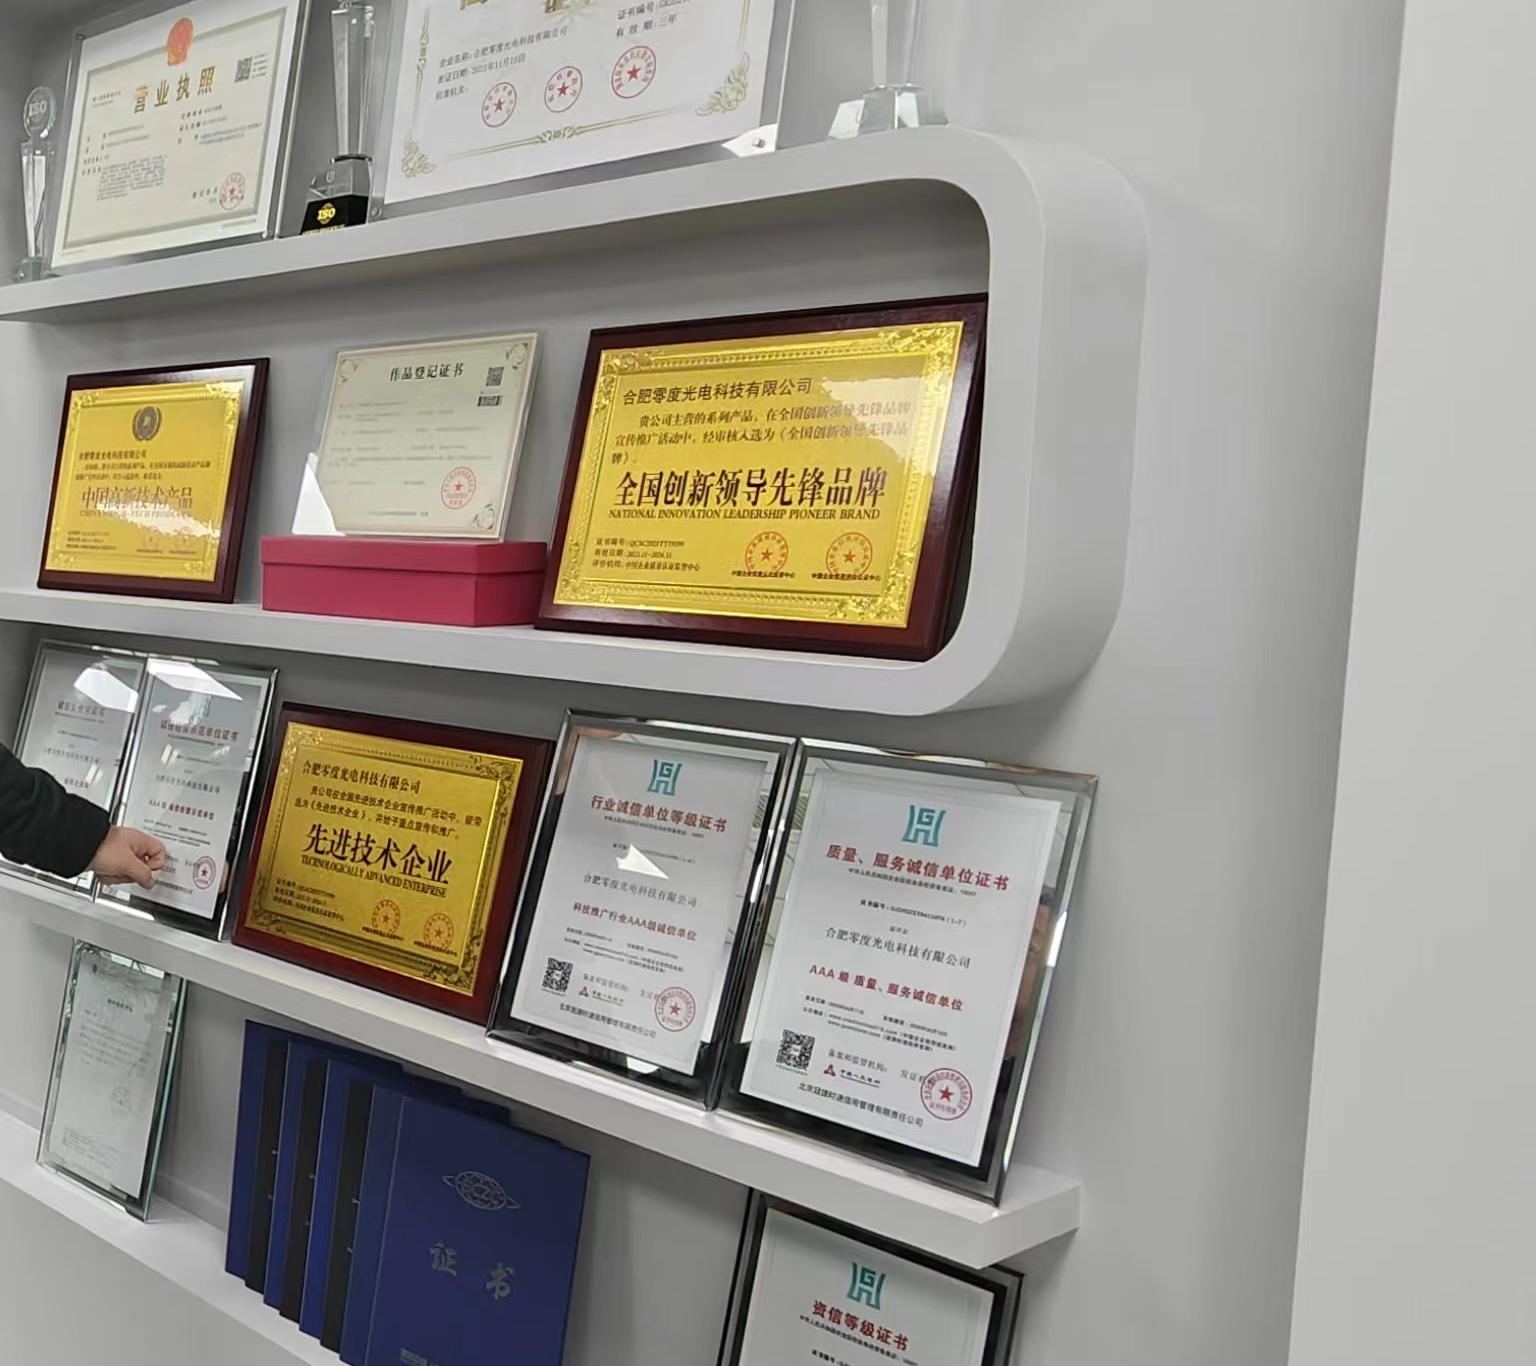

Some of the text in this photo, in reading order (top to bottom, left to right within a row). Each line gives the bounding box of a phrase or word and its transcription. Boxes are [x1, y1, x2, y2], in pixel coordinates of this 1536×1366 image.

[28, 100, 47, 117] ISO
[134, 66, 216, 114] 营业执照
[317, 207, 336, 221] ISO
[390, 363, 464, 382] 作品登记证书
[623, 377, 813, 406] 合肥零度光电科技有限公司
[613, 467, 889, 508] 全国创新领导先锋品牌
[608, 508, 881, 521] NATIONAL INNOVATION LEADERSHIP PIONEER BRAND
[302, 760, 421, 795] 合肥零度光电科技有限公司
[591, 795, 728, 833] 行业诚信单位等级证书
[303, 823, 453, 884] 先进技术企业
[826, 844, 1010, 891] 质量、服务诚信单位证书
[301, 854, 447, 898] TECHNOLOGICALLY ADVANCED ENTERPRISE
[825, 926, 971, 968] 合肥零度光电科技有限公司
[809, 964, 835, 979] AAA
[853, 975, 963, 1012] 质量、服务诚信单位
[812, 1300, 909, 1351] 资信等级证书
